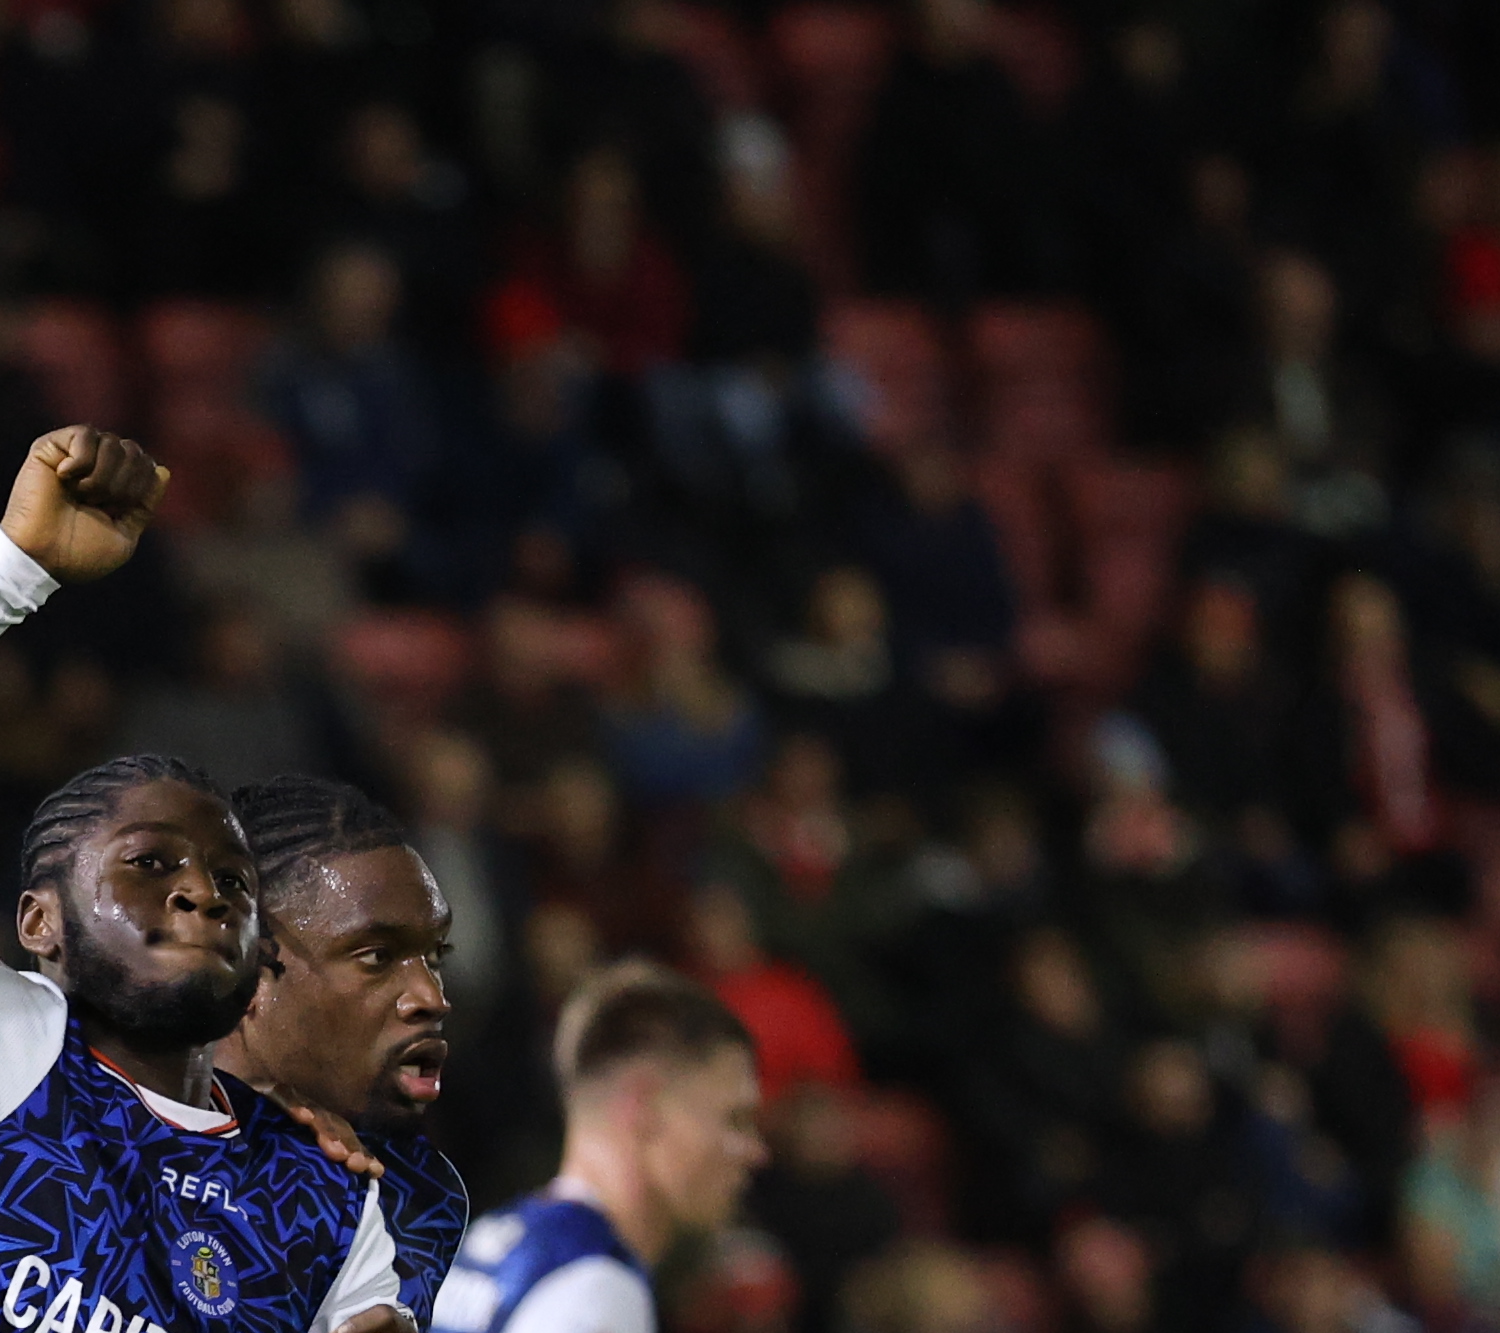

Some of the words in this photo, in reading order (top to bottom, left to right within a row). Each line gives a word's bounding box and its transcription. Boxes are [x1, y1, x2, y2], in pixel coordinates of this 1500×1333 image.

[162, 1167, 248, 1221] REFL
[177, 1231, 206, 1250] LUTON
[207, 1234, 233, 1267] TOWN
[178, 1280, 218, 1316] FOOTBALL
